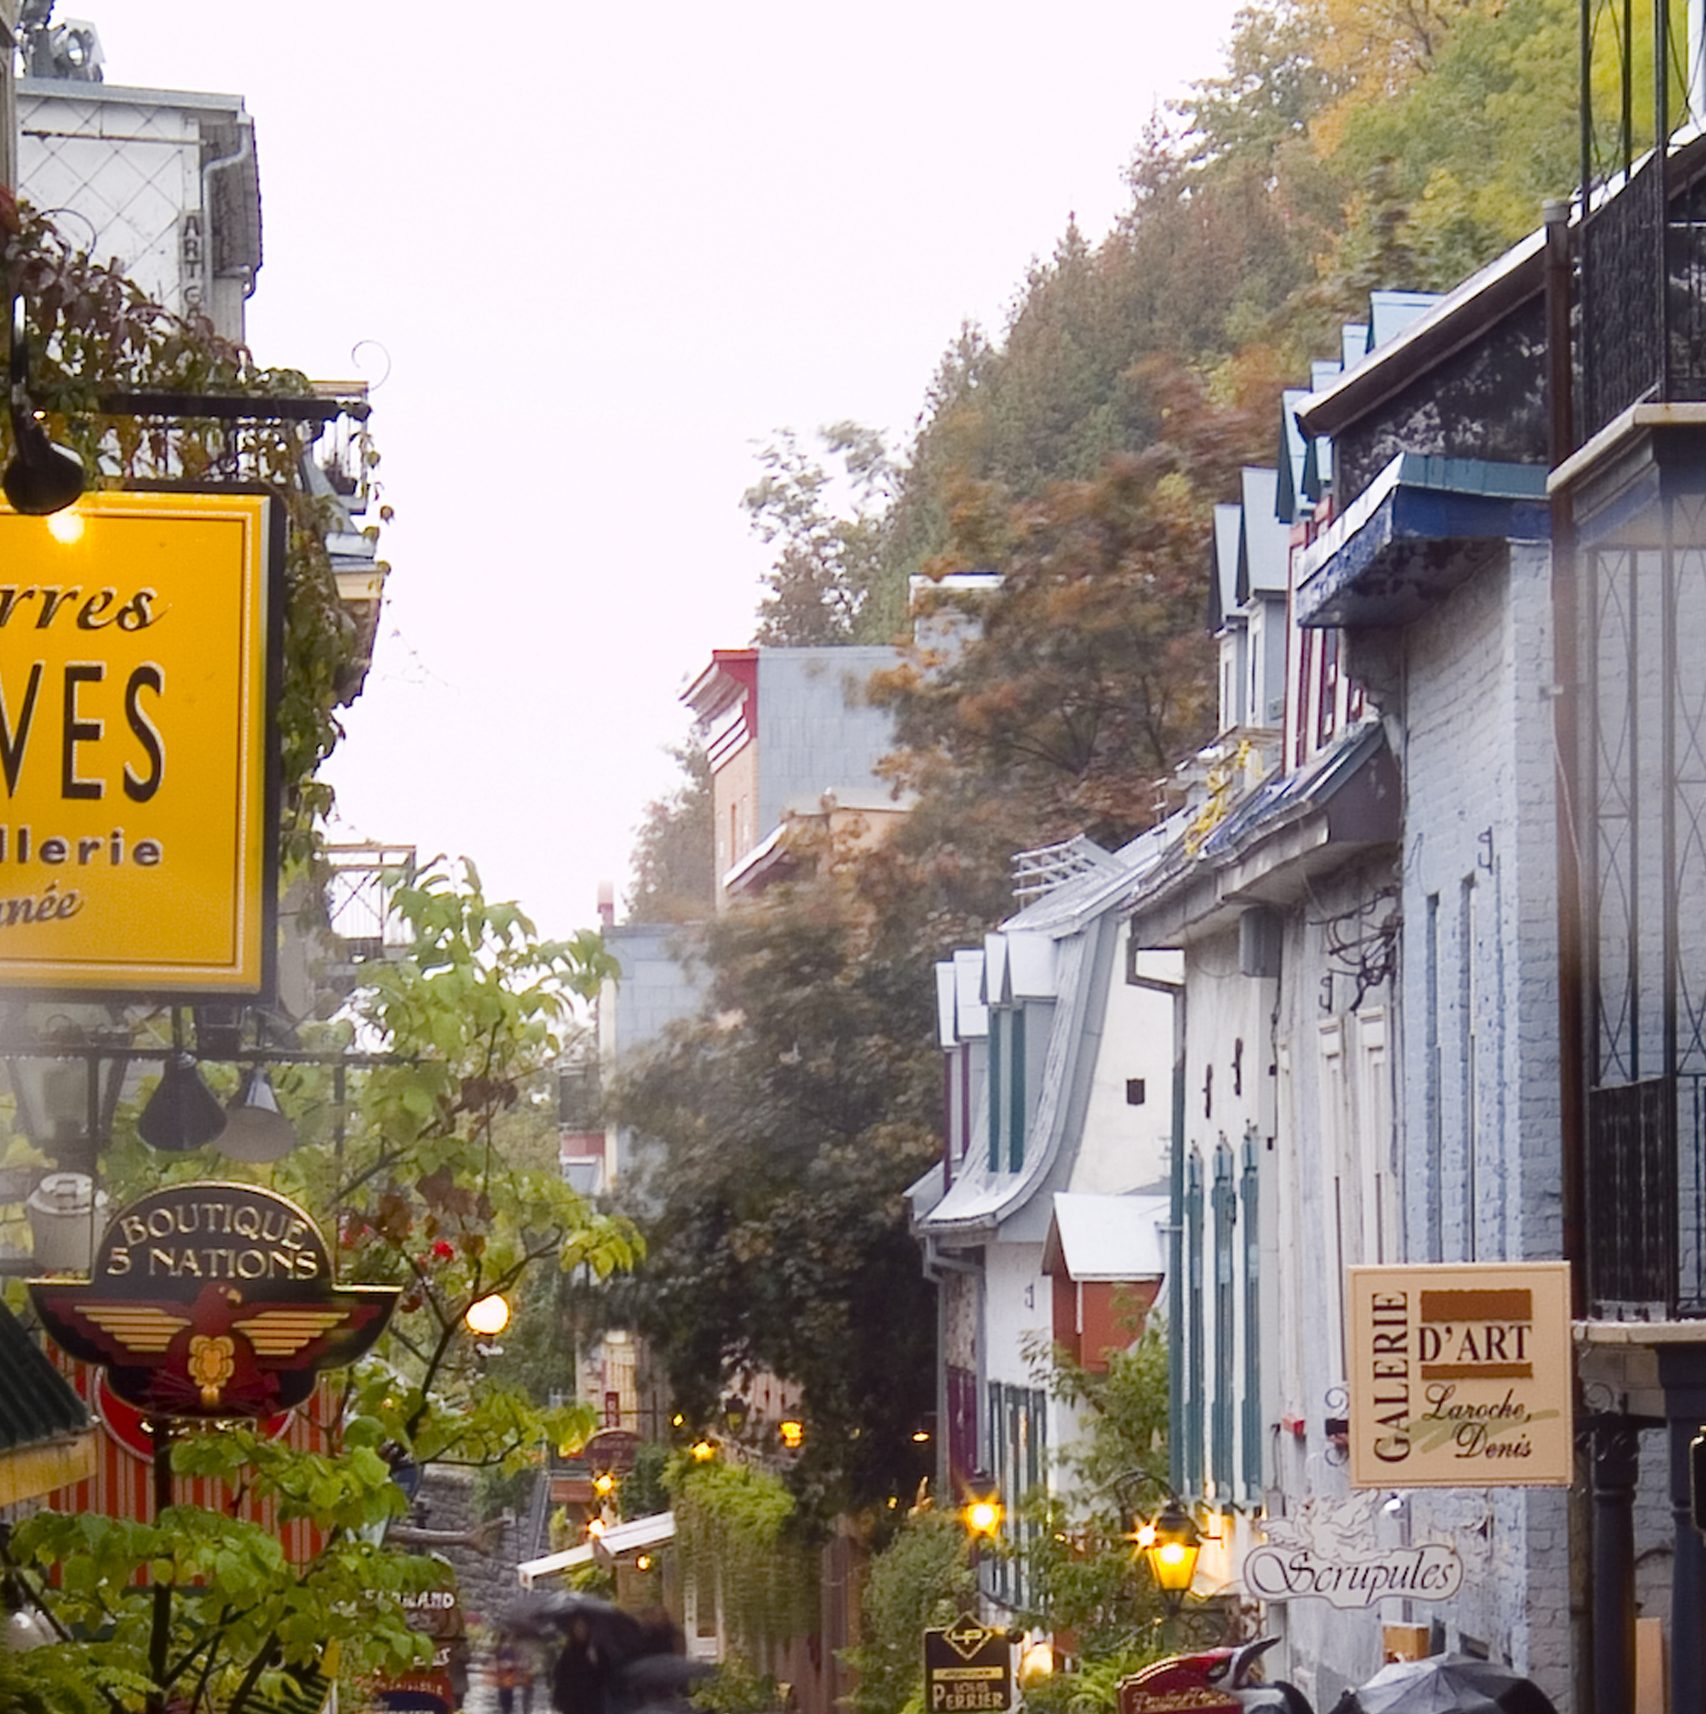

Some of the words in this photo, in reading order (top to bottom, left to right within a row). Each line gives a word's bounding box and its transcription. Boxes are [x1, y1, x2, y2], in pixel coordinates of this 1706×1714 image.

[117, 1202, 309, 1252] BOUTIQUE
[106, 1246, 133, 1277] 5
[149, 1247, 319, 1281] NATIONS
[1417, 1324, 1532, 1363] D'ART
[1372, 1290, 1412, 1463] GALERIE
[1421, 1383, 1533, 1424] Laroche,
[1451, 1421, 1532, 1460] Denis
[1250, 1549, 1455, 1605] Scrupules
[931, 1683, 1005, 1712] PERRIER
